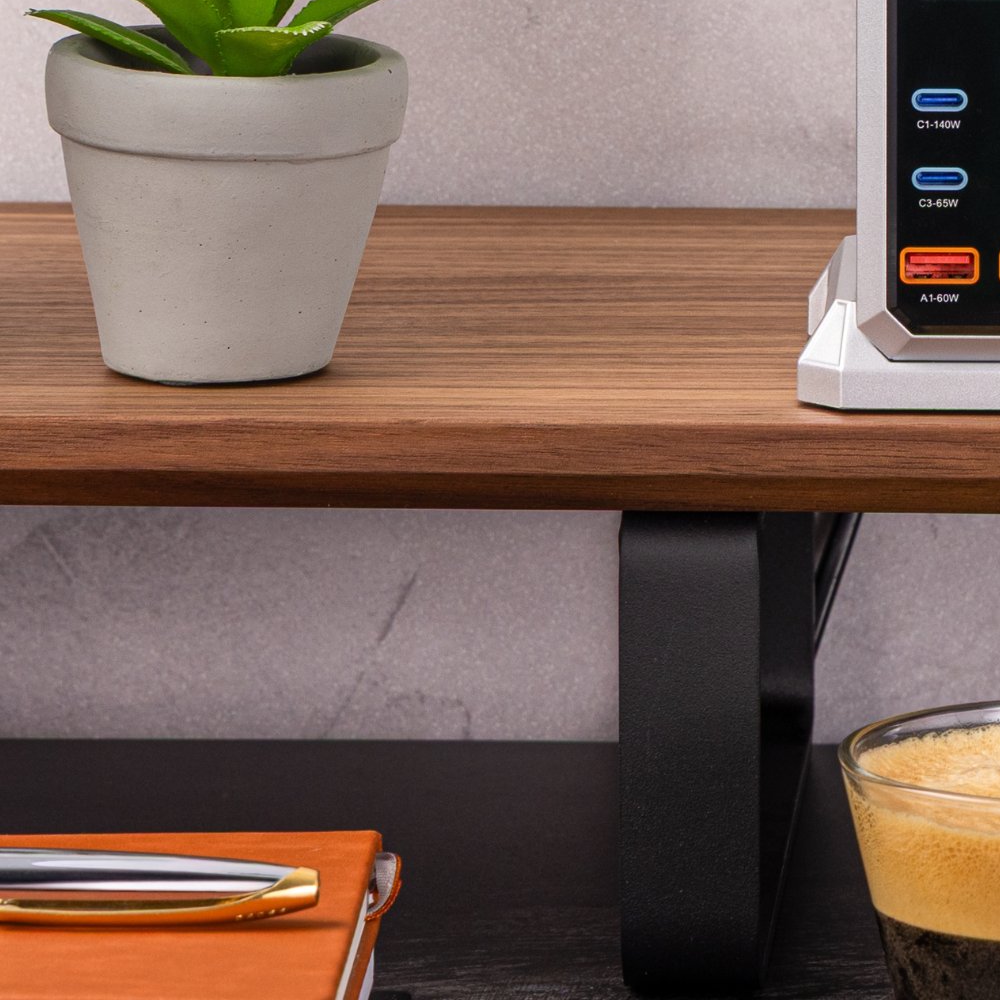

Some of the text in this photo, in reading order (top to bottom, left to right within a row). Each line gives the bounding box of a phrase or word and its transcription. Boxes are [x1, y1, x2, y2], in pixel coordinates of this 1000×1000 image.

[916, 119, 961, 130] C1-140W
[918, 198, 959, 209] C3-65W
[919, 293, 960, 303] A1-60W
